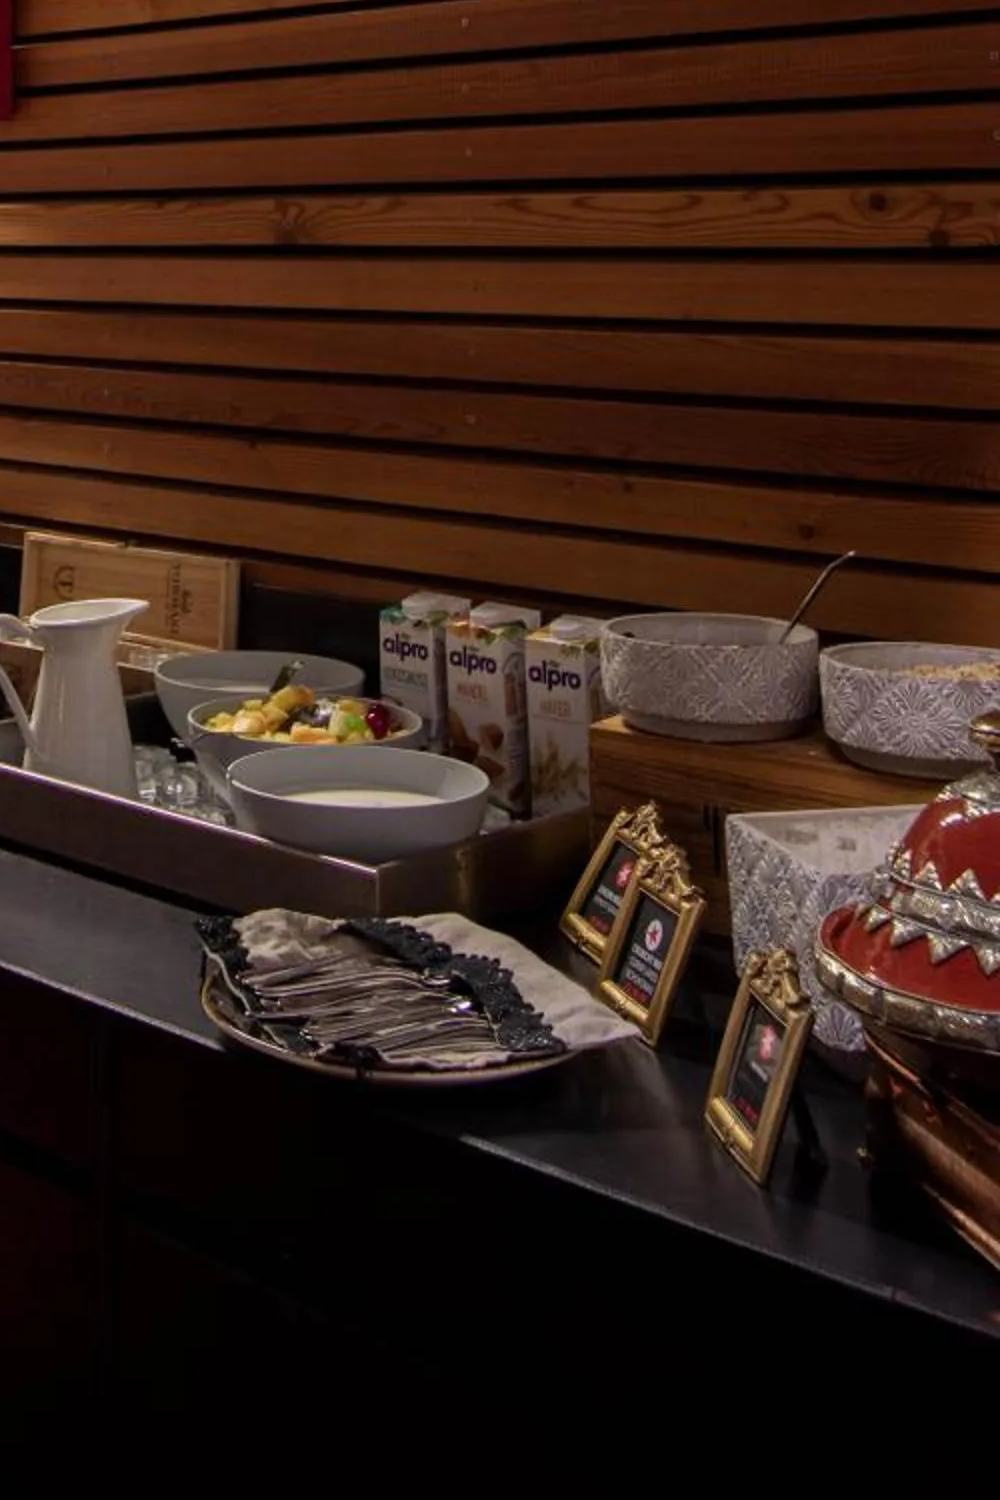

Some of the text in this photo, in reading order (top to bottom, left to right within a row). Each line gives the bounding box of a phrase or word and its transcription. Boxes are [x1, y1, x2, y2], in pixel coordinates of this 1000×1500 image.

[383, 632, 429, 661] alpro
[449, 644, 497, 676] alpro
[528, 659, 581, 692] alpro
